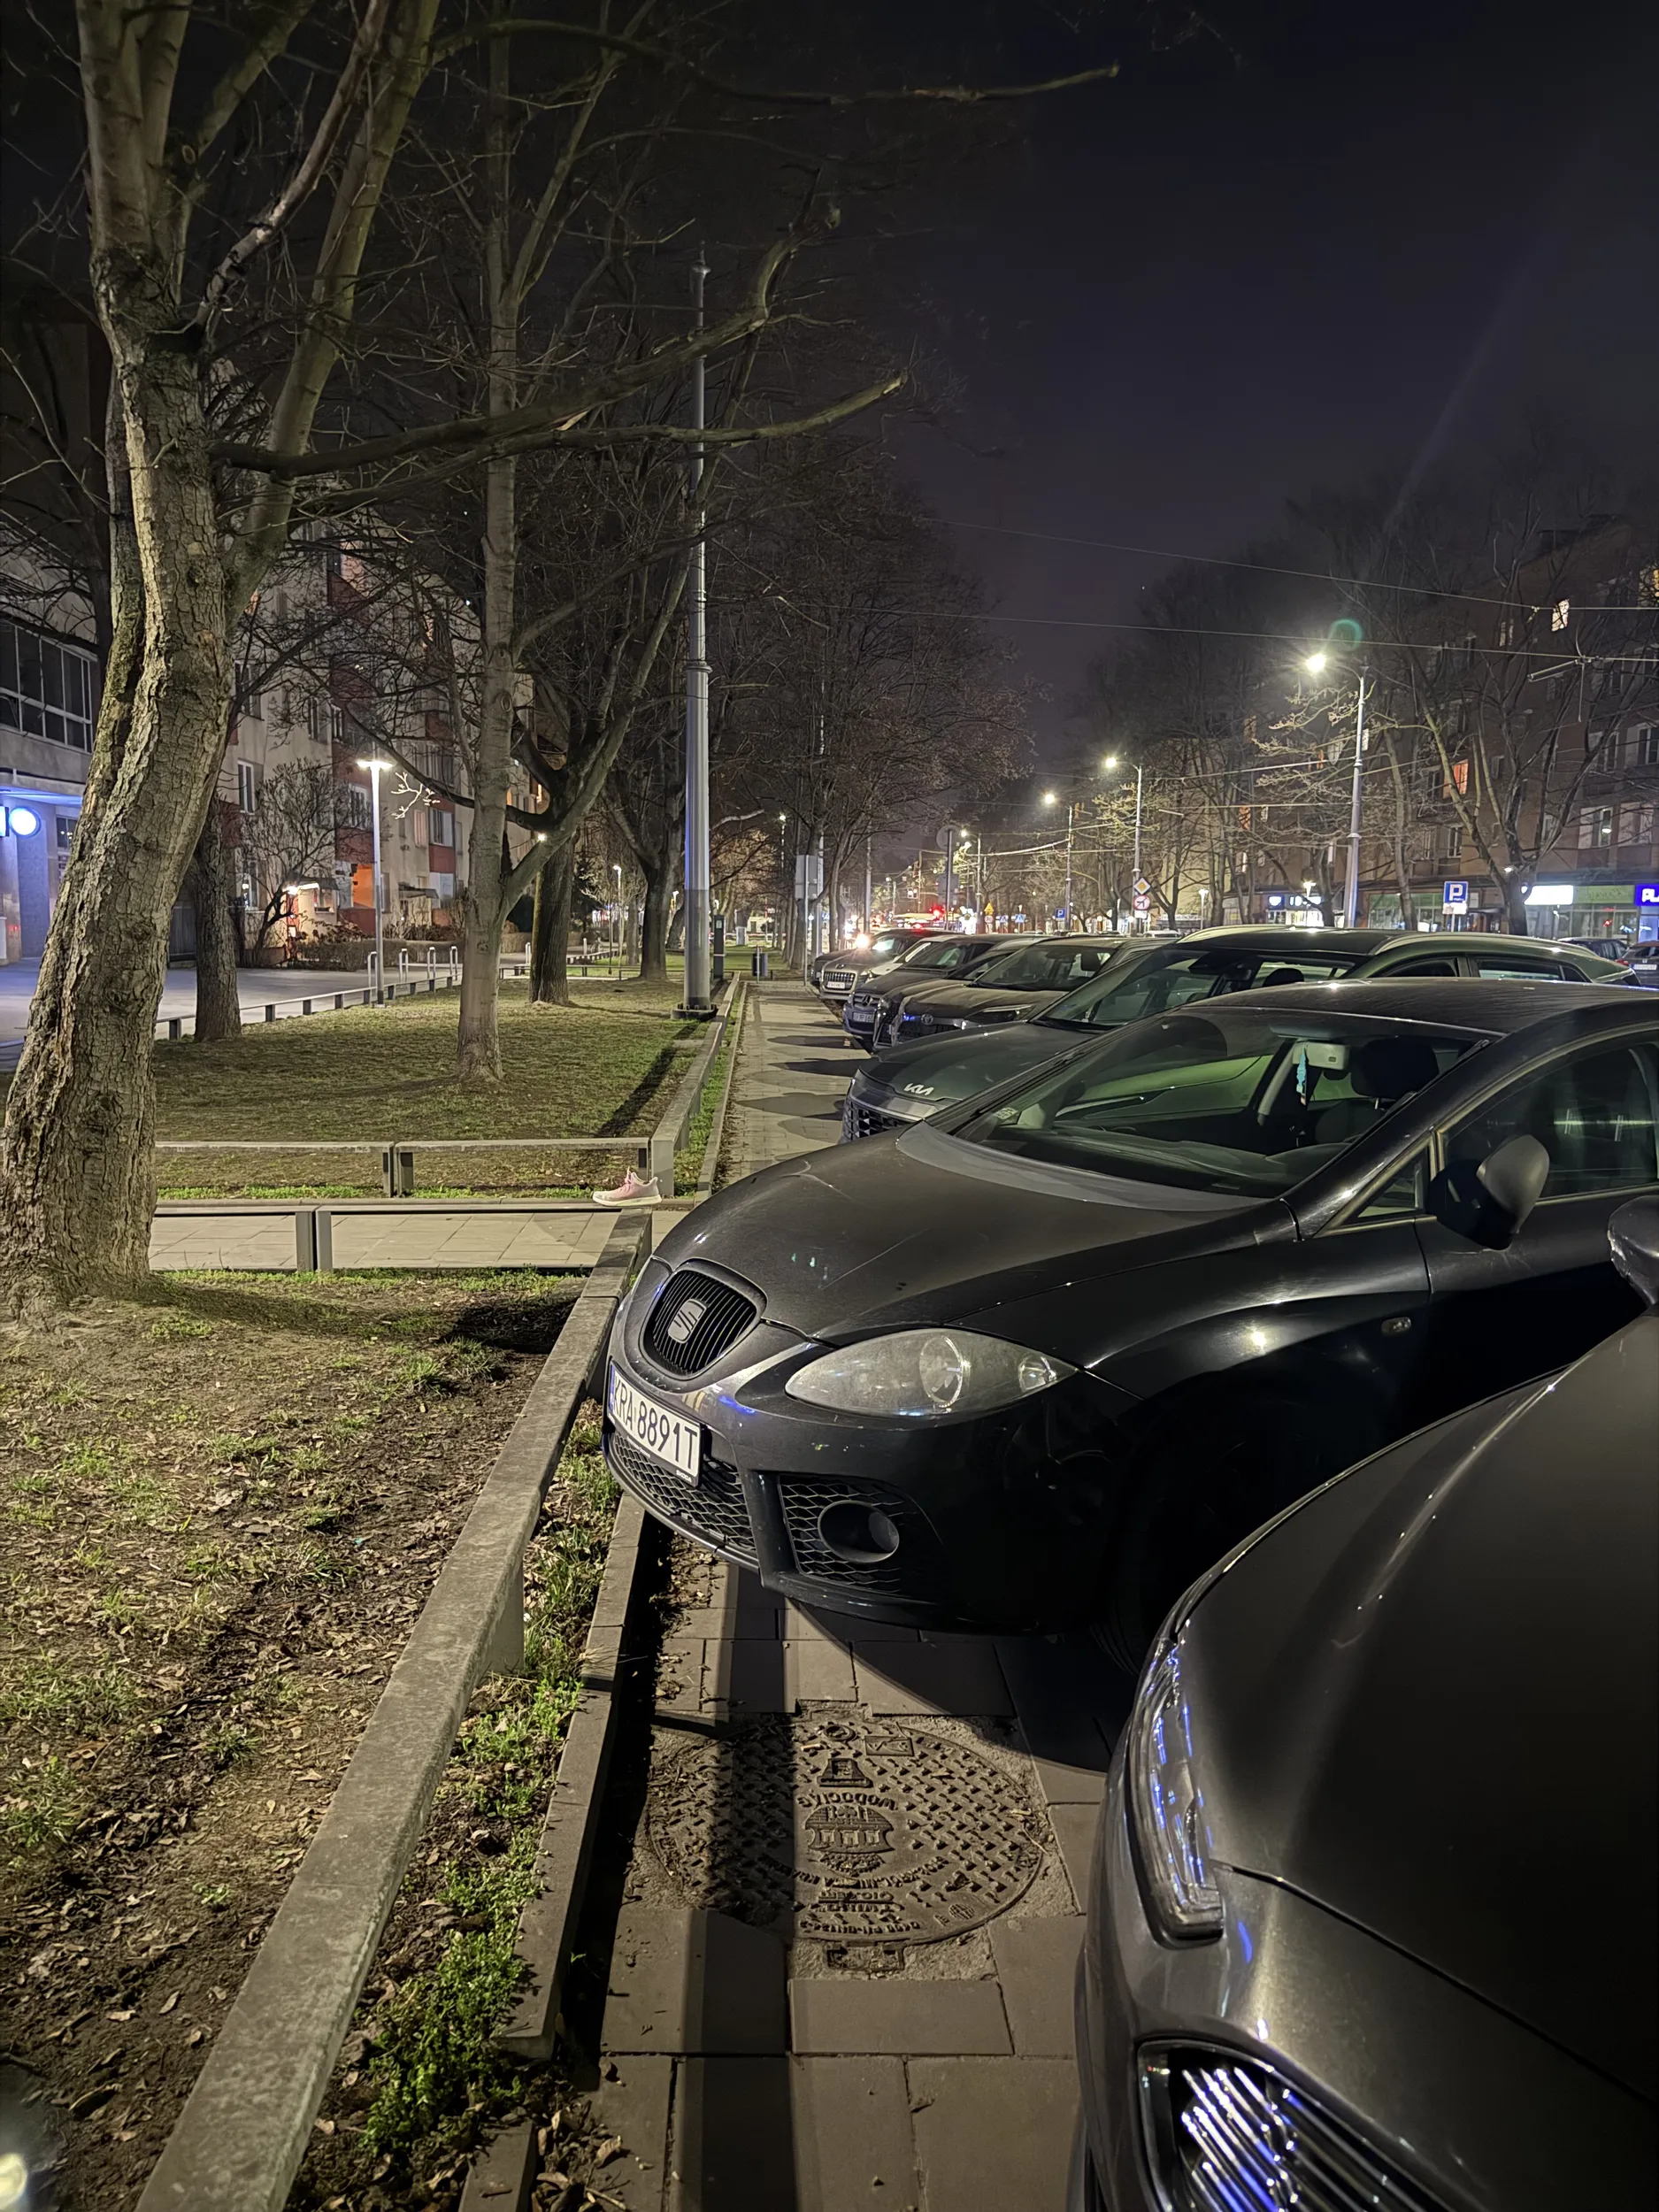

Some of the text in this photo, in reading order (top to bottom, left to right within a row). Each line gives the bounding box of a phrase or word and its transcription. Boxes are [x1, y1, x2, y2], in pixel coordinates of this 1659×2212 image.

[1449, 884, 1463, 901] P
[1641, 887, 1659, 902] PL
[903, 1082, 934, 1095] KIA
[636, 1400, 698, 1471] 8891T
